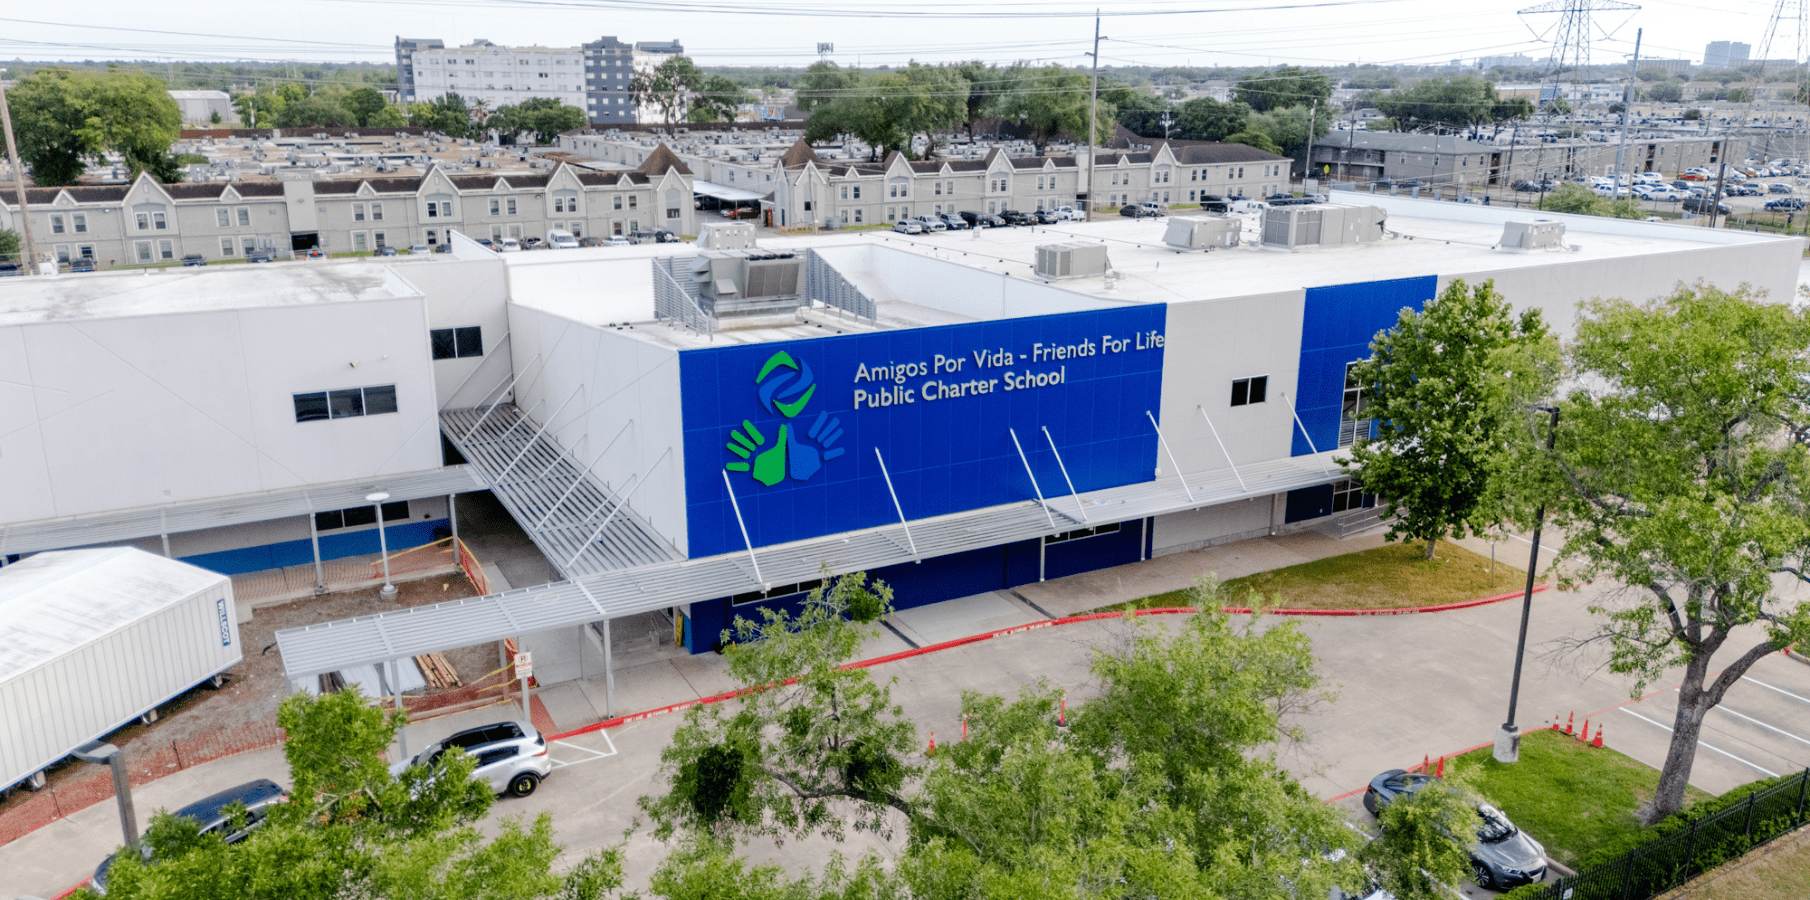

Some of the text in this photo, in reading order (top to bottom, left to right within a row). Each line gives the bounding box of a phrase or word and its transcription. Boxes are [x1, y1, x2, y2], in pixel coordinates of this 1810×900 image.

[854, 361, 928, 384] Amigos
[934, 354, 966, 374] Por
[973, 347, 1014, 368] Vida
[1033, 338, 1096, 362] Friends
[1102, 335, 1131, 354] For
[1136, 330, 1165, 350] Life
[854, 365, 1065, 410] Public Charter School
[218, 600, 230, 644] WILLSCOT
